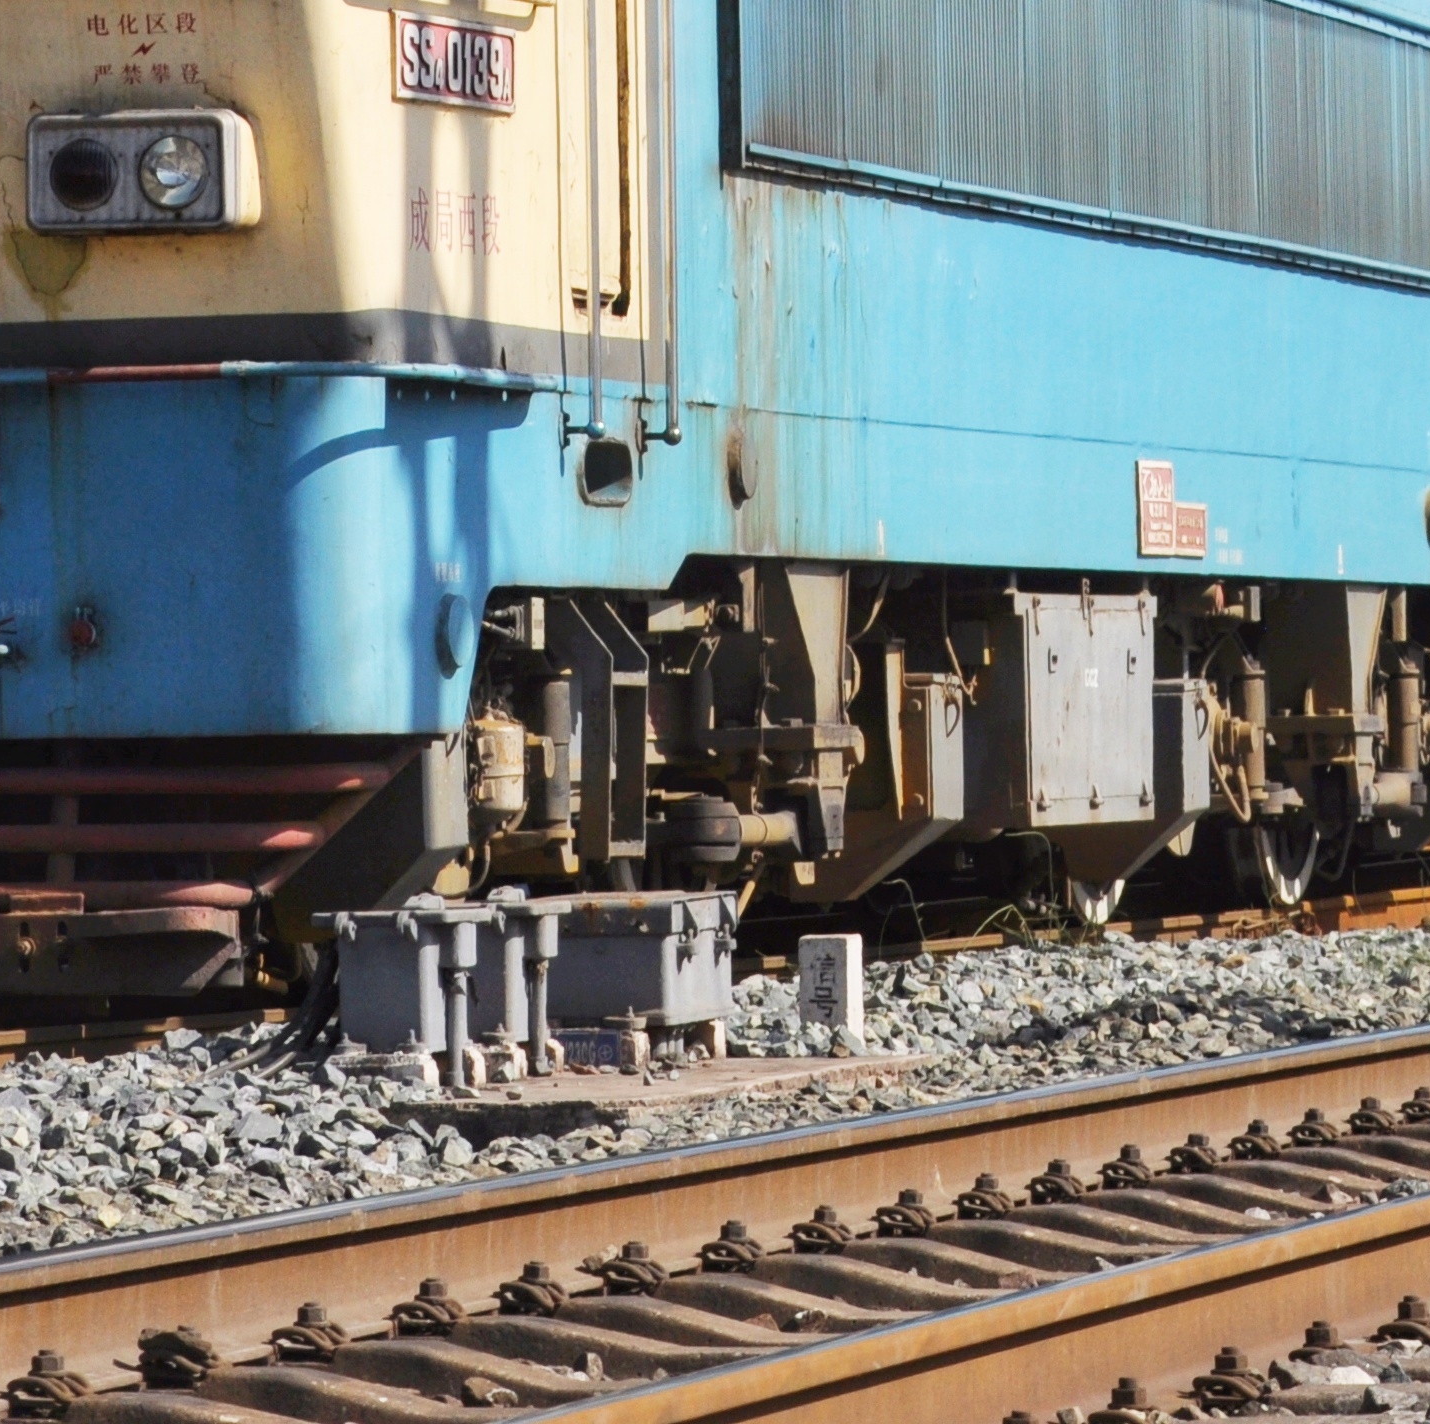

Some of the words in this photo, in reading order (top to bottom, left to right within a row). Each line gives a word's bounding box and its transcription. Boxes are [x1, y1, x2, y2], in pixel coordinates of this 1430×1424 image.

[87, 12, 197, 36] 电化区段
[93, 63, 200, 85] 严禁攀登
[410, 187, 501, 256] 成局西段
